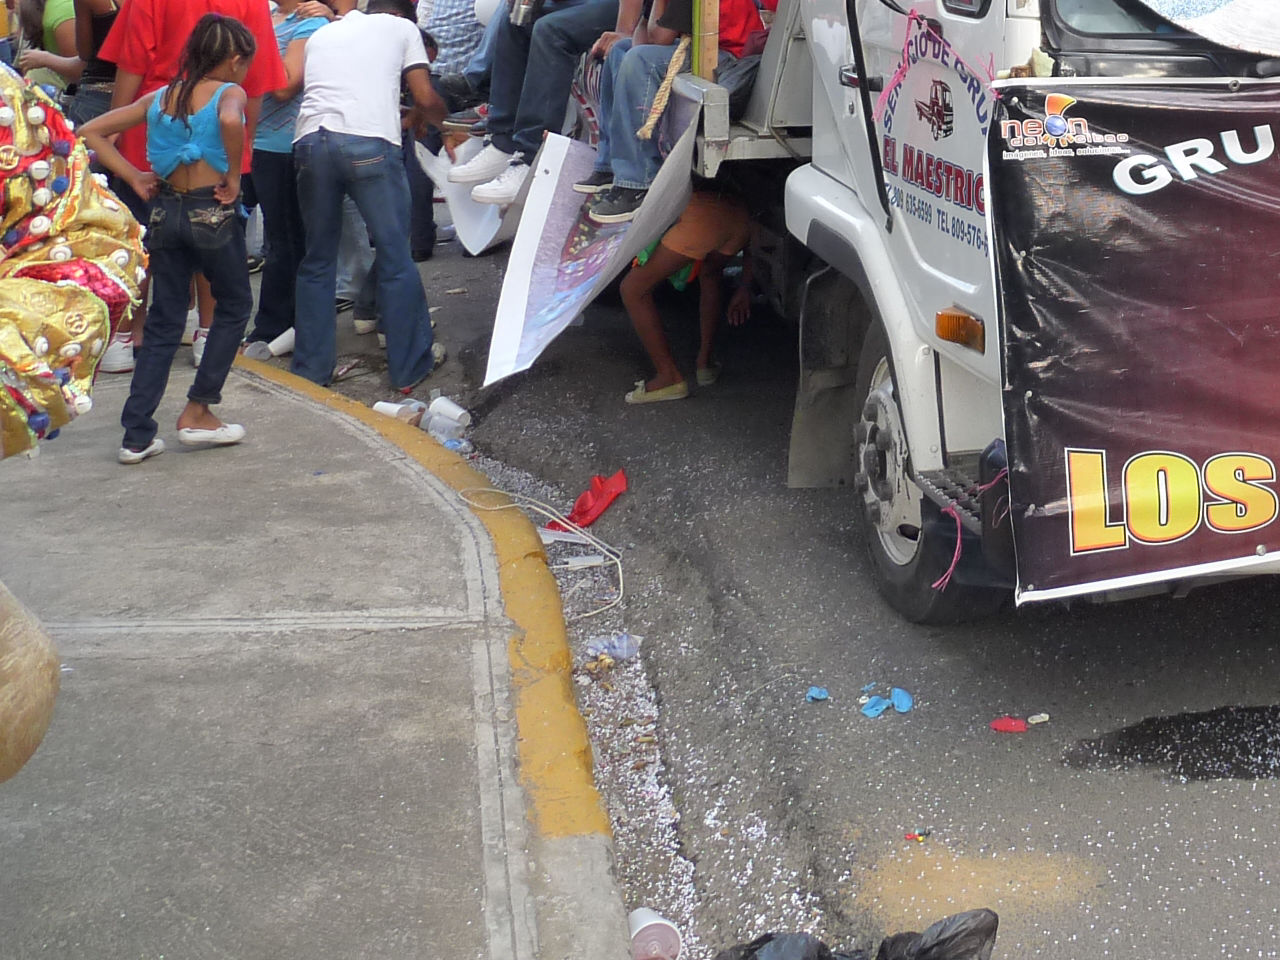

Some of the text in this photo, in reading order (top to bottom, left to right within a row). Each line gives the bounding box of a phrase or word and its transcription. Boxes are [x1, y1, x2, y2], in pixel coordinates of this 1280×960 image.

[954, 57, 988, 137] GRU
[883, 134, 899, 177] EL
[937, 208, 950, 234] TEL
[1065, 447, 1279, 556] LOS
